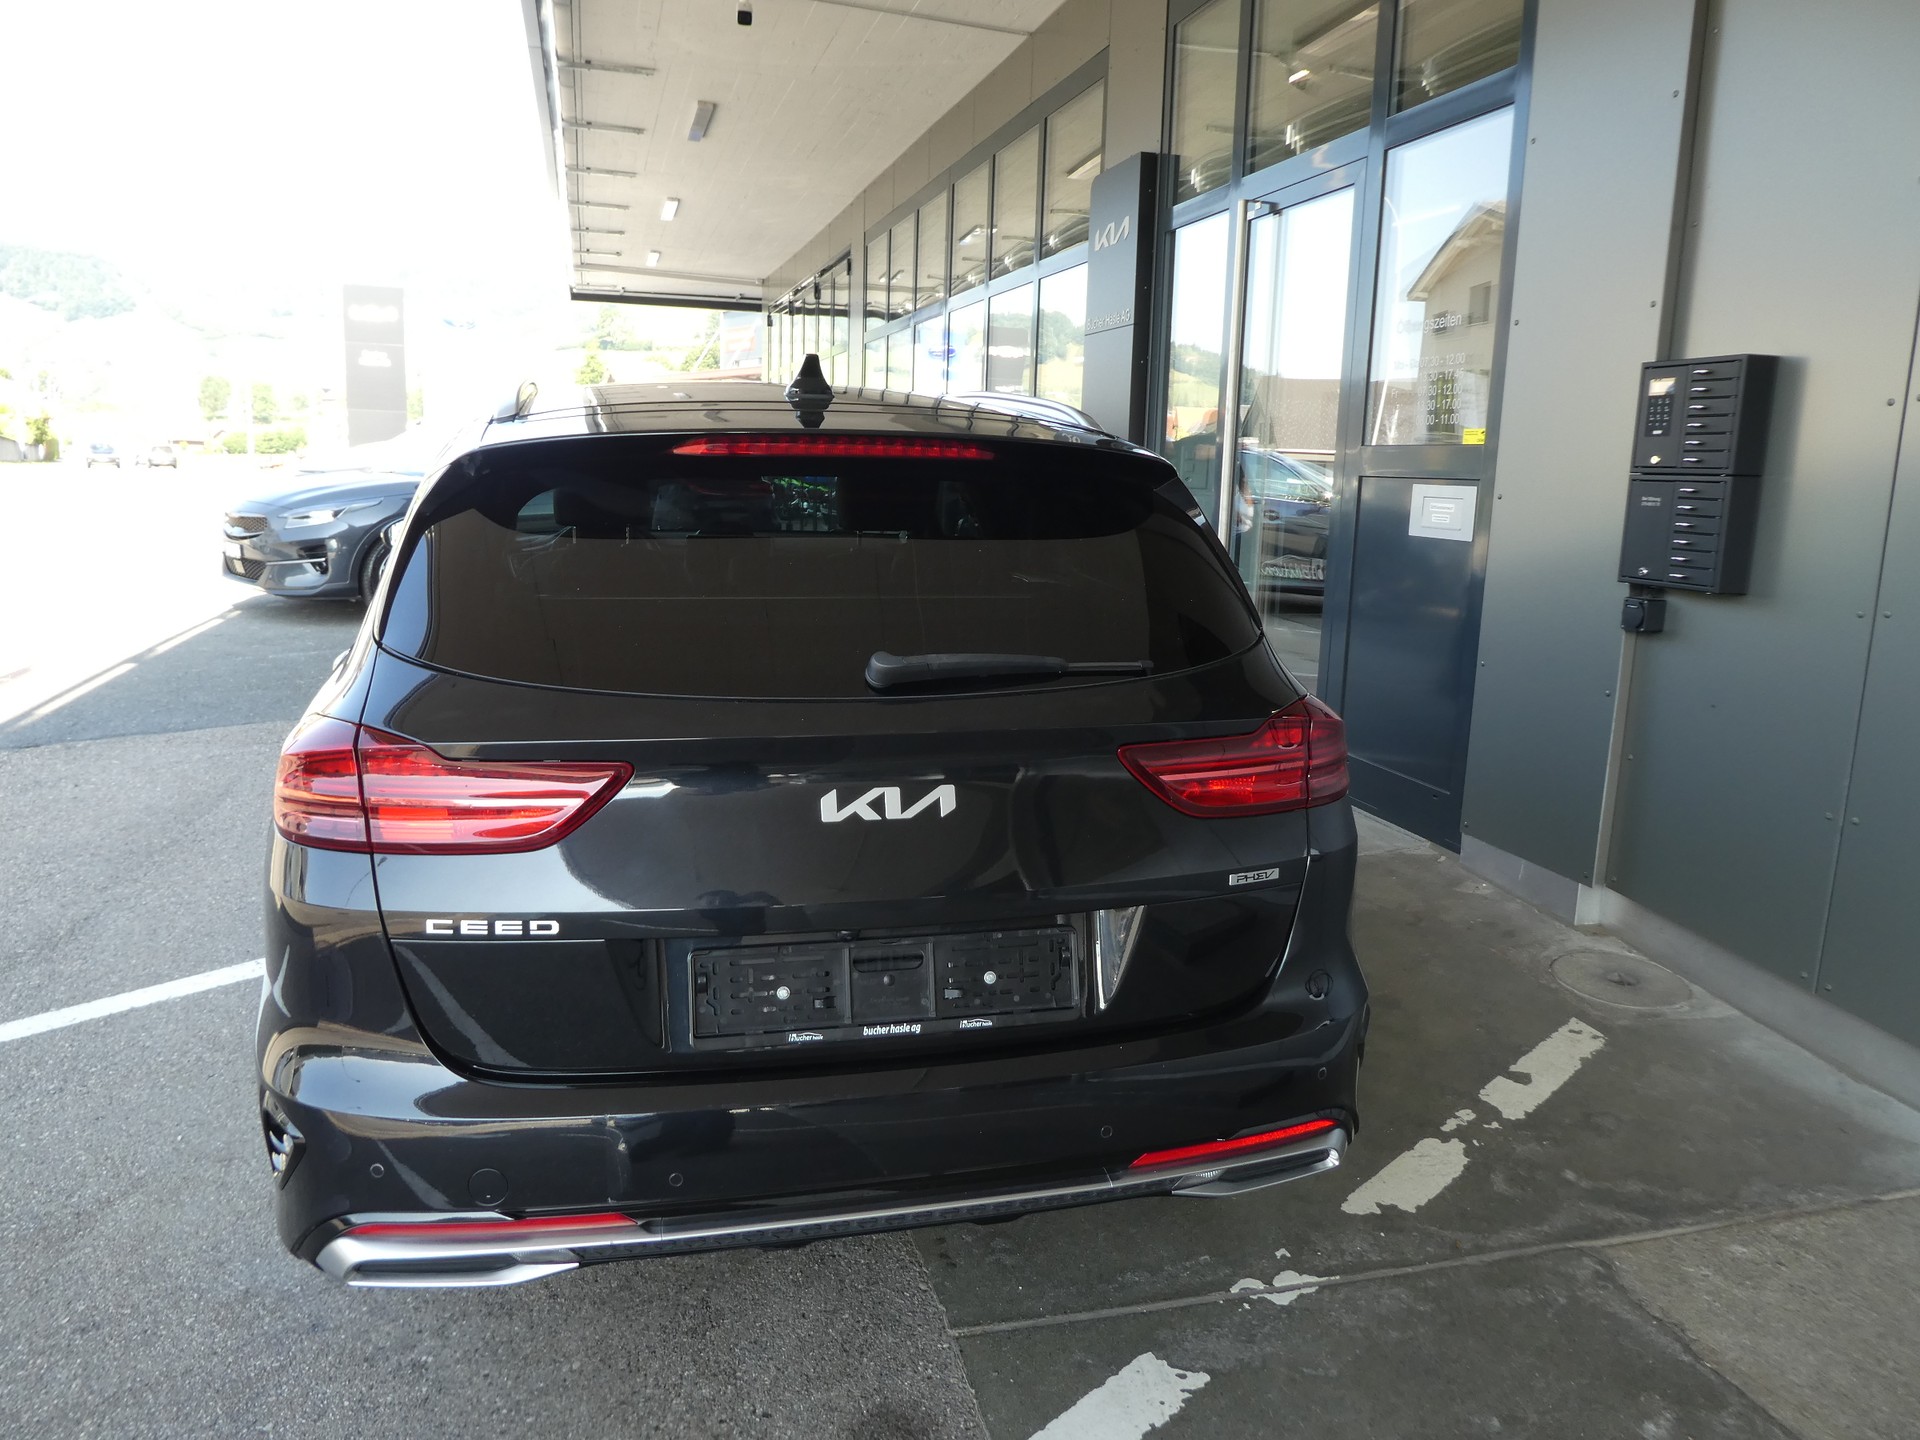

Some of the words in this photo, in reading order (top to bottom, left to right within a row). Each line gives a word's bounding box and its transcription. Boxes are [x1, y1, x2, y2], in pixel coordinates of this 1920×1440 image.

[1094, 215, 1130, 252] KIA
[1443, 383, 1463, 395] 12.00
[1441, 398, 1462, 410] 17.00
[1440, 413, 1460, 425] 11.00
[821, 784, 956, 822] KIA
[1236, 870, 1275, 883] PHEV
[426, 919, 559, 935] CEED
[863, 1025, 890, 1036] bucher
[890, 1022, 911, 1034] hasle
[911, 1023, 921, 1034] ag
